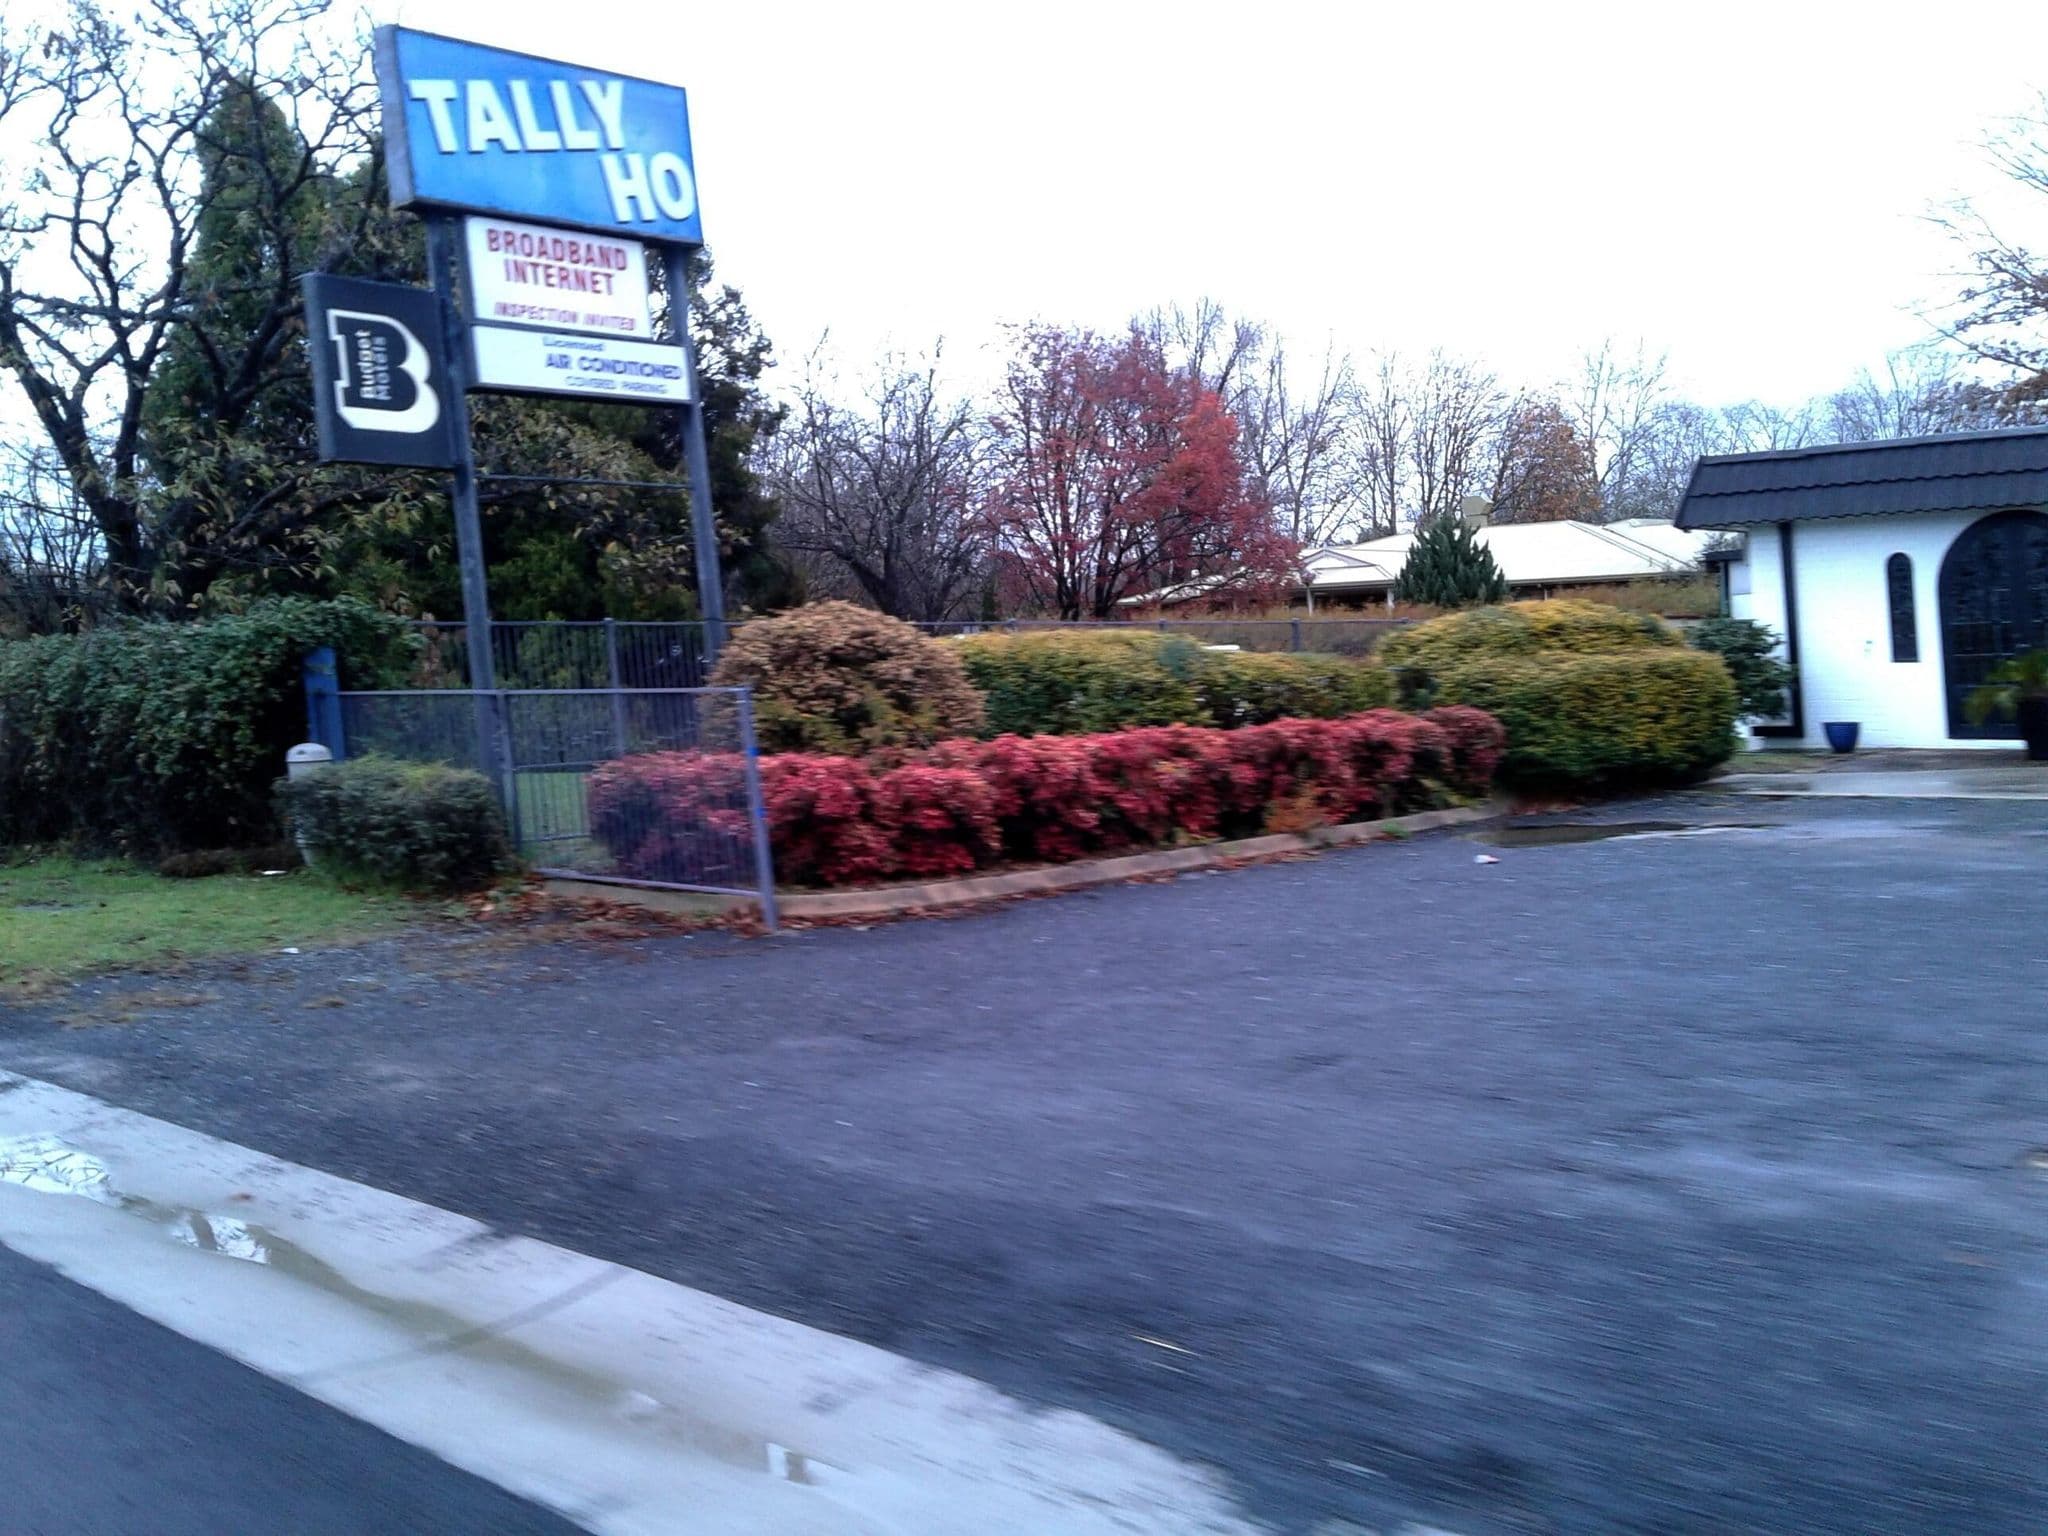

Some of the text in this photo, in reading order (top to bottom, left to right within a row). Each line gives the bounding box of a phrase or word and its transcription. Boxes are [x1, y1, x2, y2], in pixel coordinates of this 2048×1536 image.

[408, 78, 625, 153] TALLY
[600, 151, 695, 223] HO
[486, 228, 627, 271] BROADBAND
[504, 258, 614, 296] INTERNET
[546, 353, 681, 379] AIR CONDITIONED
